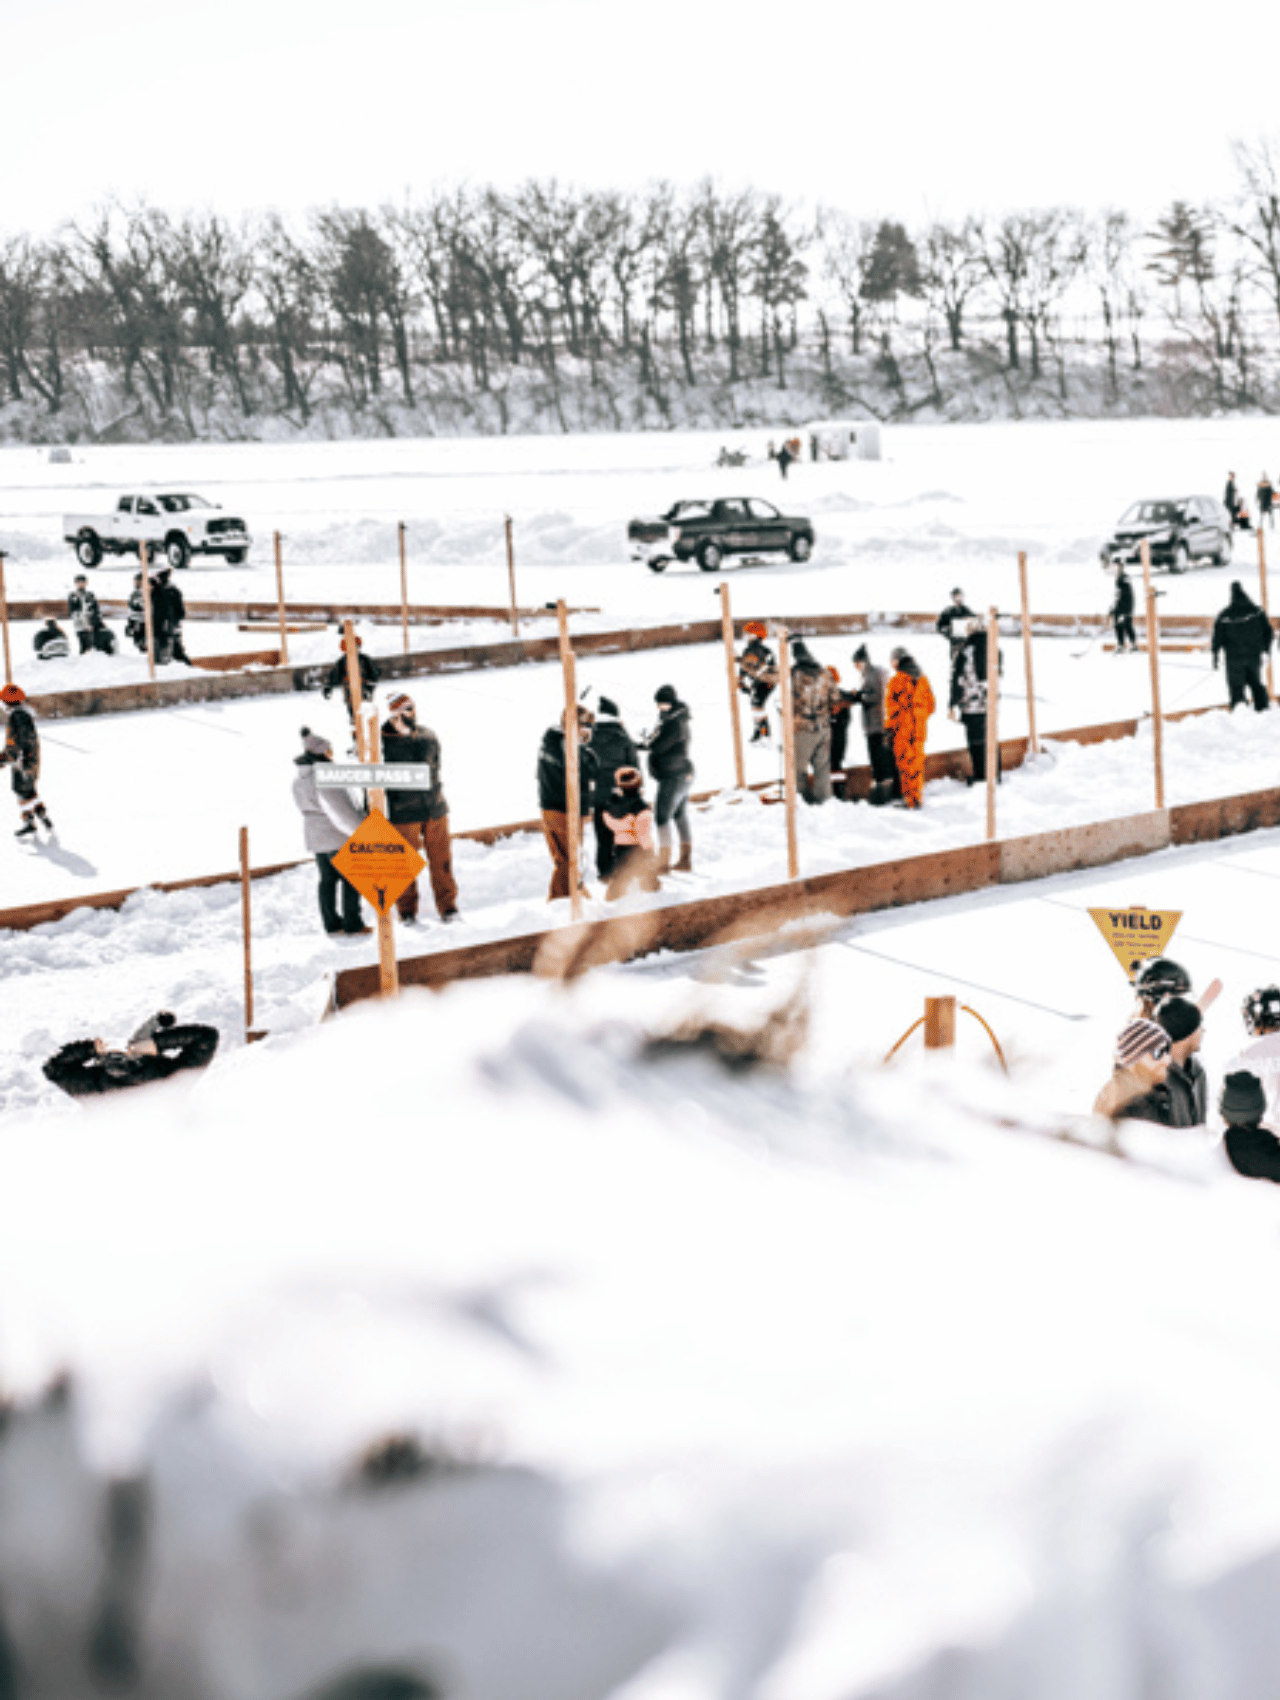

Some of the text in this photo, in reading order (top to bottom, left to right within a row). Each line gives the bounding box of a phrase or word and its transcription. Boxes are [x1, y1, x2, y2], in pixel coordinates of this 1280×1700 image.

[375, 770, 411, 783] PASS
[349, 842, 405, 854] CAUTION
[1108, 912, 1163, 930] YIELD
